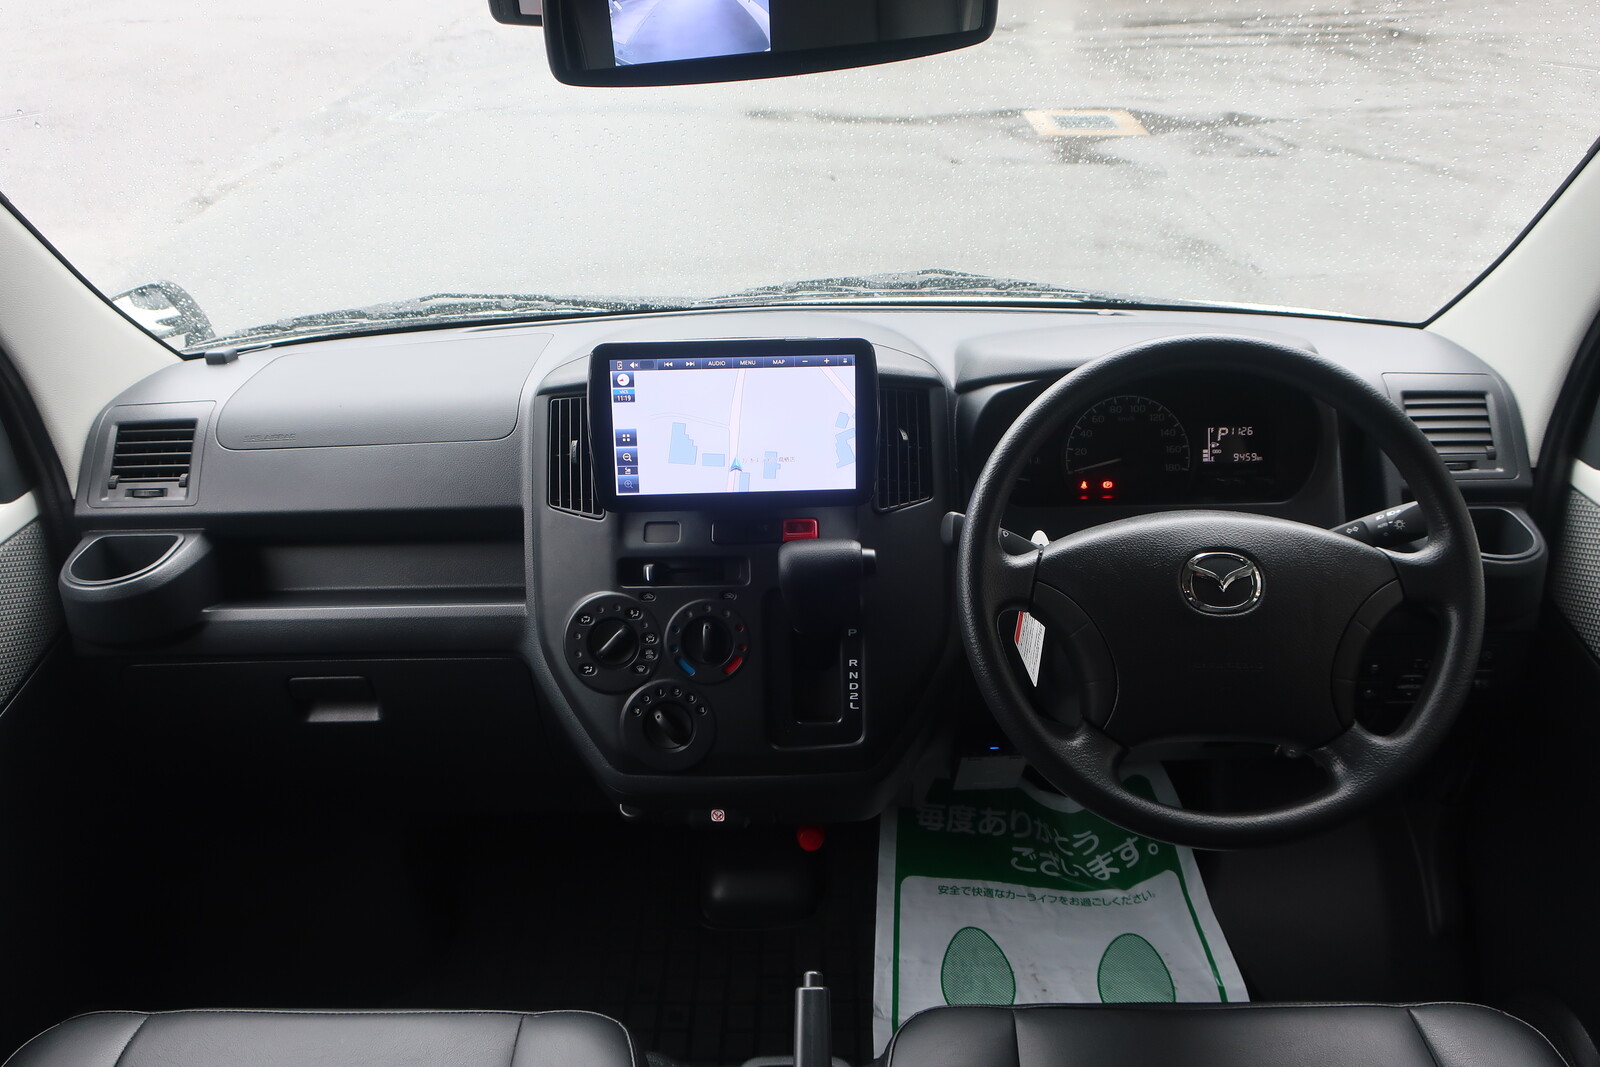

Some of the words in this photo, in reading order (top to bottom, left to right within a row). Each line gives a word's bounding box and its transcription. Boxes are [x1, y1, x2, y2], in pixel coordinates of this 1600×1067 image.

[1150, 414, 1165, 422] 120
[1160, 428, 1176, 436] 140
[1165, 464, 1180, 472] 180
[848, 628, 858, 637] P
[848, 659, 858, 667] R
[849, 672, 858, 680] N
[850, 702, 860, 710] L
[915, 803, 1099, 857] 毎度ありがとう
[1010, 835, 1159, 881] ございます。
